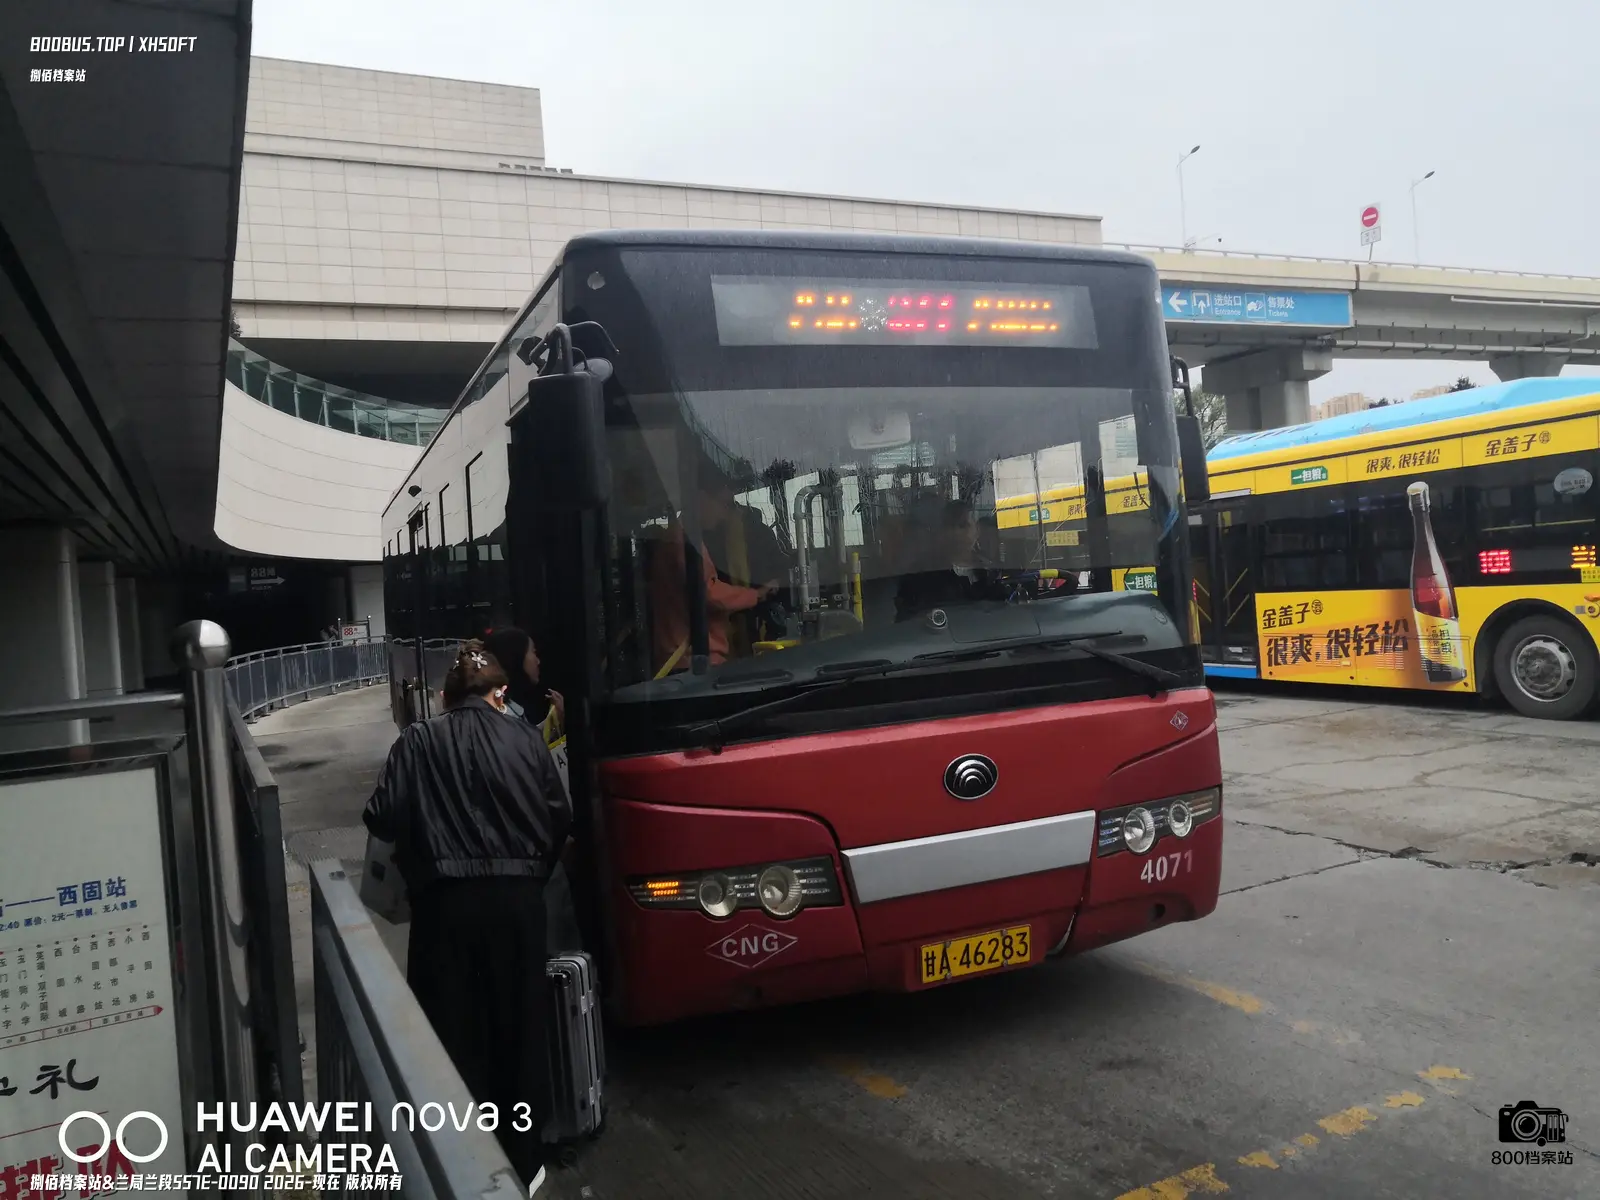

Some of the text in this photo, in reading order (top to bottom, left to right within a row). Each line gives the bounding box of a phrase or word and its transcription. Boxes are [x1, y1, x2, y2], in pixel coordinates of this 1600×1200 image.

[1214, 293, 1242, 307] 进站口
[1267, 296, 1295, 309] 售票处
[1214, 307, 1241, 316] Entrance
[1268, 310, 1289, 318] Tickets
[1485, 433, 1537, 458] 金盖子
[1262, 602, 1311, 630] 金盖子
[1140, 850, 1194, 883] 4071
[722, 933, 779, 958] CNG
